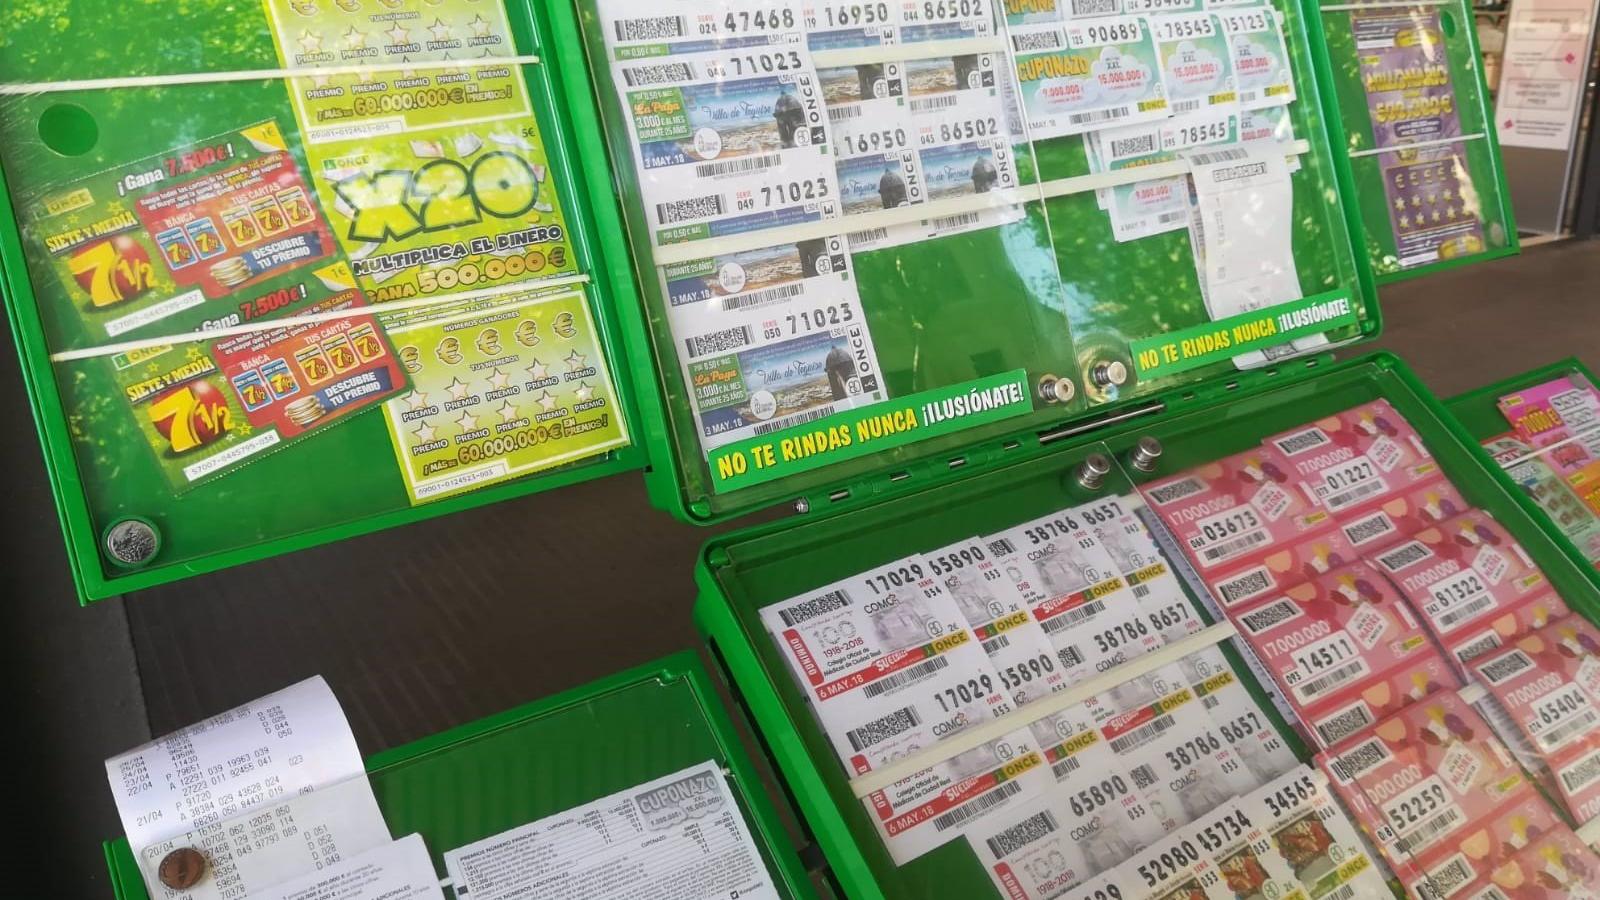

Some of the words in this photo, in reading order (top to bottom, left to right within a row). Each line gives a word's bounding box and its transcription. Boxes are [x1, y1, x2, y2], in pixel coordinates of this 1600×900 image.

[700, 23, 717, 34] 024
[724, 9, 794, 32] 47468
[825, 3, 888, 26] 16950
[904, 11, 918, 21] 044
[924, 0, 983, 20] 86502
[1224, 14, 1264, 32] 15123
[1088, 24, 1137, 42] 90689
[1165, 19, 1211, 38] 78545
[296, 52, 334, 64] PREMIO
[341, 47, 378, 60] PREMIO
[385, 43, 421, 54] PREMIO
[427, 39, 462, 50] PREMIO
[468, 35, 501, 47] PREMIO
[731, 51, 802, 75] 71023
[1018, 56, 1089, 82] CUPONAZO
[306, 87, 344, 99] PREMIO
[351, 82, 388, 94] PREMIO
[395, 78, 430, 88] PREMIO
[436, 72, 471, 84] PREMIO
[477, 68, 510, 79] PREMIO
[800, 76, 819, 124] ONCE
[522, 127, 535, 137] 5€
[844, 128, 906, 154] 16950
[921, 134, 935, 144] 045
[940, 118, 998, 142] 86502
[1181, 122, 1226, 145] 78545
[644, 159, 651, 167] 3
[652, 156, 674, 167] MAY.
[995, 142, 1010, 183] ONCE
[903, 153, 920, 197] ONCE
[332, 150, 539, 243] X20
[737, 199, 754, 210] 049
[761, 178, 829, 207] 71023
[45, 230, 84, 253] SIETE
[84, 227, 97, 240] Y
[95, 211, 138, 235] MEDIA
[252, 237, 306, 258] DESCUBRE
[257, 257, 270, 269] TU
[272, 246, 310, 264] PREMIO
[352, 242, 468, 276] MULTIPLICA
[470, 236, 494, 254] EL
[498, 226, 564, 248] DINERO
[69, 241, 123, 307] 7
[672, 296, 680, 305] 3
[680, 293, 699, 304] MAY.
[700, 290, 710, 299] 18
[320, 320, 351, 338] CARTAS
[764, 327, 781, 340] 050
[786, 303, 853, 334] 71023
[1139, 349, 1159, 371] NO
[1161, 344, 1179, 363] TE
[1181, 329, 1231, 359] RINDAS
[1232, 317, 1277, 344] NUNCA
[1279, 298, 1350, 333] ¡ILUSIÓNATE!
[240, 354, 270, 371] BANCA
[850, 327, 870, 373] ONCE
[126, 381, 165, 402] SIETE
[164, 376, 176, 388] Y
[174, 356, 216, 384] MEDIA
[323, 372, 377, 398] DESCUBRE
[757, 370, 785, 385] Villa
[330, 395, 345, 408] TU
[344, 380, 381, 402] PREMIO
[402, 406, 439, 423] PREMIO
[444, 396, 480, 411] PREMIO
[486, 386, 521, 401] PREMIO
[526, 376, 559, 392] PREMIO
[564, 367, 596, 382] PREMIO
[148, 386, 201, 452] 7
[413, 439, 448, 456] PREMIO
[455, 428, 490, 444] PREMIO
[496, 418, 530, 434] PREMIO
[536, 408, 568, 423] PREMIO
[574, 399, 605, 413] PREMIO
[705, 427, 712, 436] 3
[712, 423, 732, 434] MAY.
[717, 454, 747, 481] NO
[751, 446, 777, 469] TE
[781, 426, 852, 463] RINDAS
[856, 408, 918, 443] NUNCA
[921, 381, 1025, 427] ¡ILUSIÓNATE!
[1327, 463, 1373, 490] 01227
[1082, 502, 1124, 526] 8657
[1203, 511, 1258, 541] 03673
[1024, 516, 1079, 545] 38786
[1078, 538, 1095, 549] 053
[929, 546, 985, 576] 65890
[1139, 564, 1166, 581] ONCE
[865, 563, 924, 594] 17029
[983, 569, 1001, 581] 053
[1093, 580, 1121, 595] ONCE
[924, 586, 942, 599] 054
[1435, 576, 1483, 608] 81322
[997, 612, 1027, 631] ONCE
[1150, 602, 1189, 630] 8657
[823, 637, 864, 658] 1918-2018
[935, 633, 966, 651] ONCE
[1094, 618, 1148, 652] 38786
[790, 638, 817, 676] DOMINGO
[1299, 639, 1353, 675] 14511
[819, 690, 827, 698] 6
[826, 680, 850, 696] MAY.
[853, 675, 864, 684] 18
[934, 674, 994, 713] 17029
[1206, 674, 1232, 690] ONCE
[1162, 690, 1190, 709] ONCE
[1539, 689, 1586, 724] 65404
[278, 728, 292, 738] 050
[1220, 712, 1262, 744] 8657
[1066, 731, 1097, 752] ONCE
[1166, 731, 1220, 771] 38786
[227, 754, 251, 768] 19963
[1006, 756, 1039, 776] ONCE
[128, 781, 152, 796] 22/04
[182, 780, 208, 797] 27223
[211, 773, 226, 785] 011
[231, 763, 254, 778] 92455
[258, 755, 272, 767] 041
[186, 791, 211, 807] 91720
[222, 804, 237, 816] 050
[268, 785, 283, 798] 019
[640, 776, 718, 814] CUPONAZO
[1069, 774, 1128, 817] 65890
[1264, 775, 1318, 818] 34565
[1388, 783, 1447, 831] 52259
[136, 810, 163, 826] 21/04
[191, 801, 214, 818] 38384
[249, 812, 272, 828] 12035
[275, 805, 290, 818] 050
[280, 815, 293, 827] 114
[889, 825, 896, 834] 6
[896, 813, 920, 829] MAY.
[923, 805, 934, 816] 18
[283, 825, 298, 838] 089
[314, 824, 328, 837] 051
[318, 834, 332, 846] 052
[149, 842, 174, 859] 20/04
[1253, 839, 1271, 856] 053
[216, 873, 240, 890] 59694
[322, 843, 336, 857] 028
[221, 884, 245, 900] 70378
[326, 853, 340, 866] 049
[1137, 840, 1199, 888] 52980
[1339, 857, 1368, 878] ONCE
[1202, 871, 1219, 889] 053
